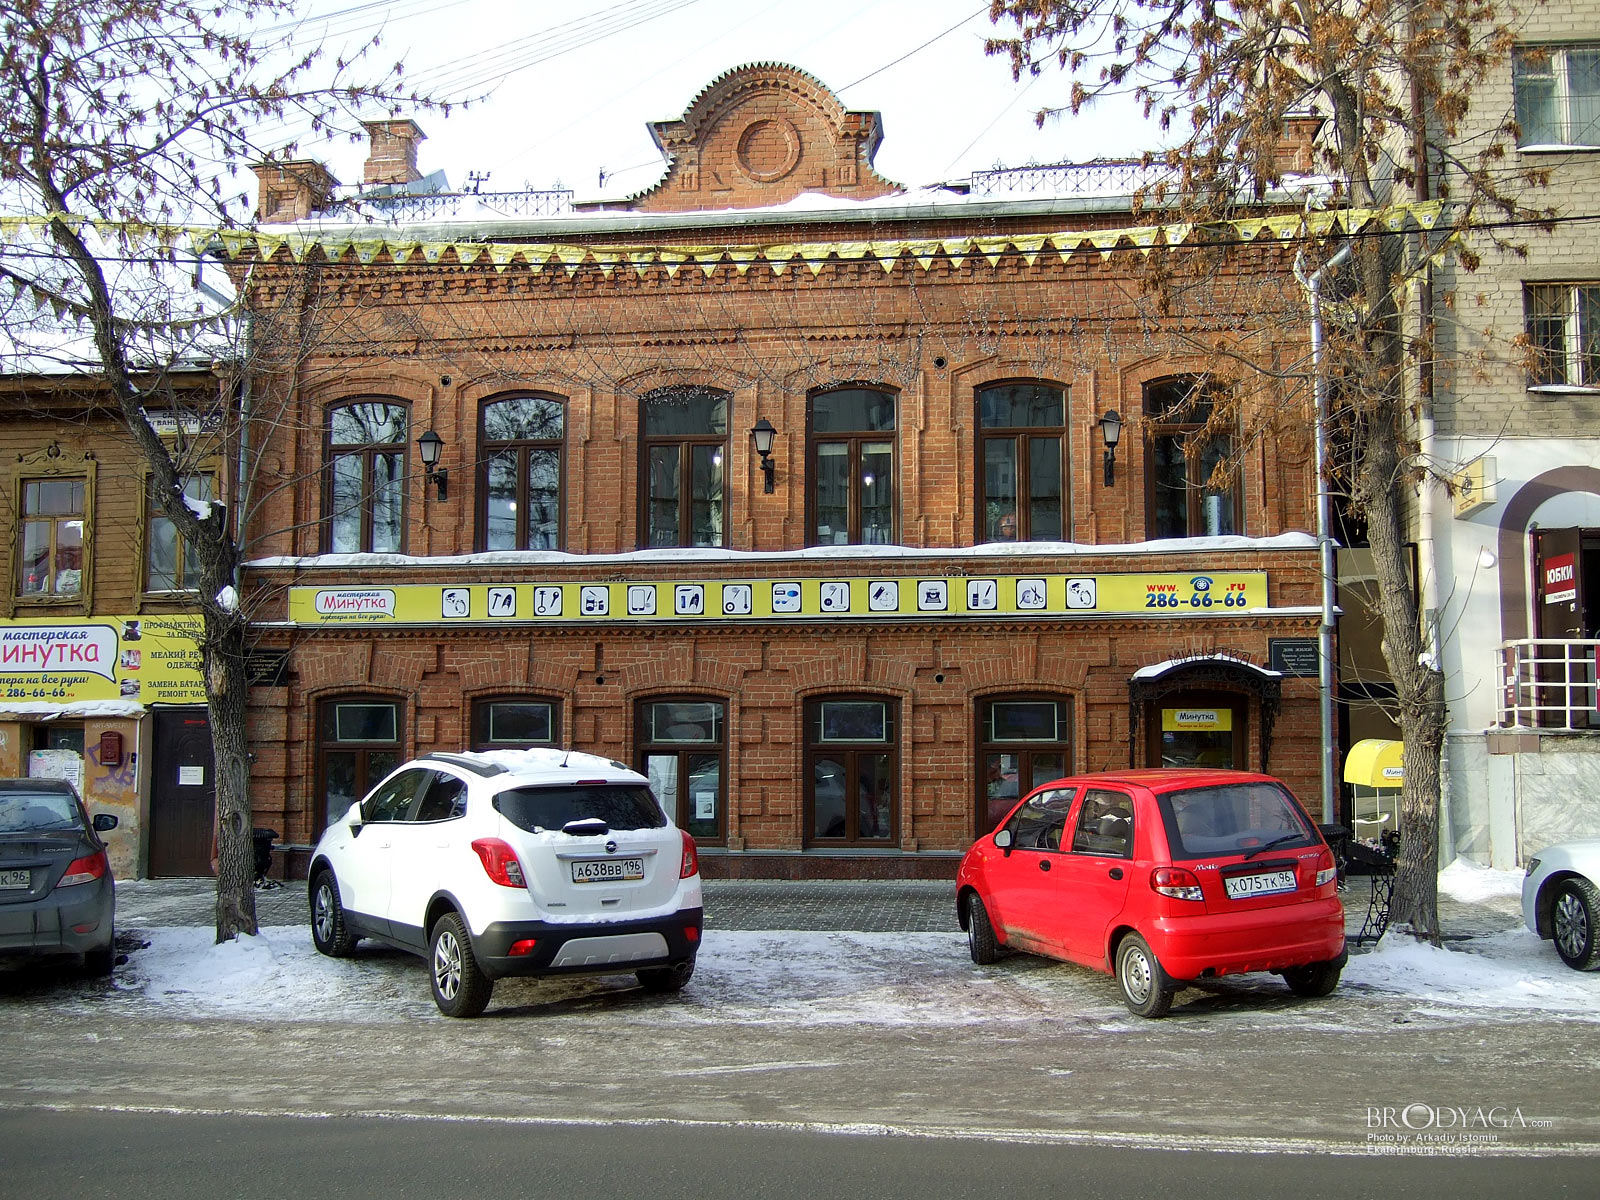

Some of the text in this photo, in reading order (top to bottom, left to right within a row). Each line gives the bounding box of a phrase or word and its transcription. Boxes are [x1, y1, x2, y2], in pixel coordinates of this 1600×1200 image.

[1547, 565, 1573, 584] ЮБКИ
[1146, 583, 1246, 592] www. .ru
[324, 596, 386, 610] Минутка
[1145, 592, 1247, 608] 286-66-66
[3, 630, 89, 645] мастерская
[0, 643, 100, 668] инутка
[150, 649, 203, 659] МЕЛКИЙ РЕ
[26, 677, 40, 685] на
[41, 674, 59, 684] все
[60, 676, 89, 687] руки!
[6, 688, 66, 698] 286-66-66
[157, 690, 188, 698] РЕМОНТ
[1179, 712, 1214, 721] Минутка
[577, 860, 641, 878] А638ВВ 196
[12, 871, 26, 881] 96
[1230, 872, 1291, 893] Х075ТК 96
